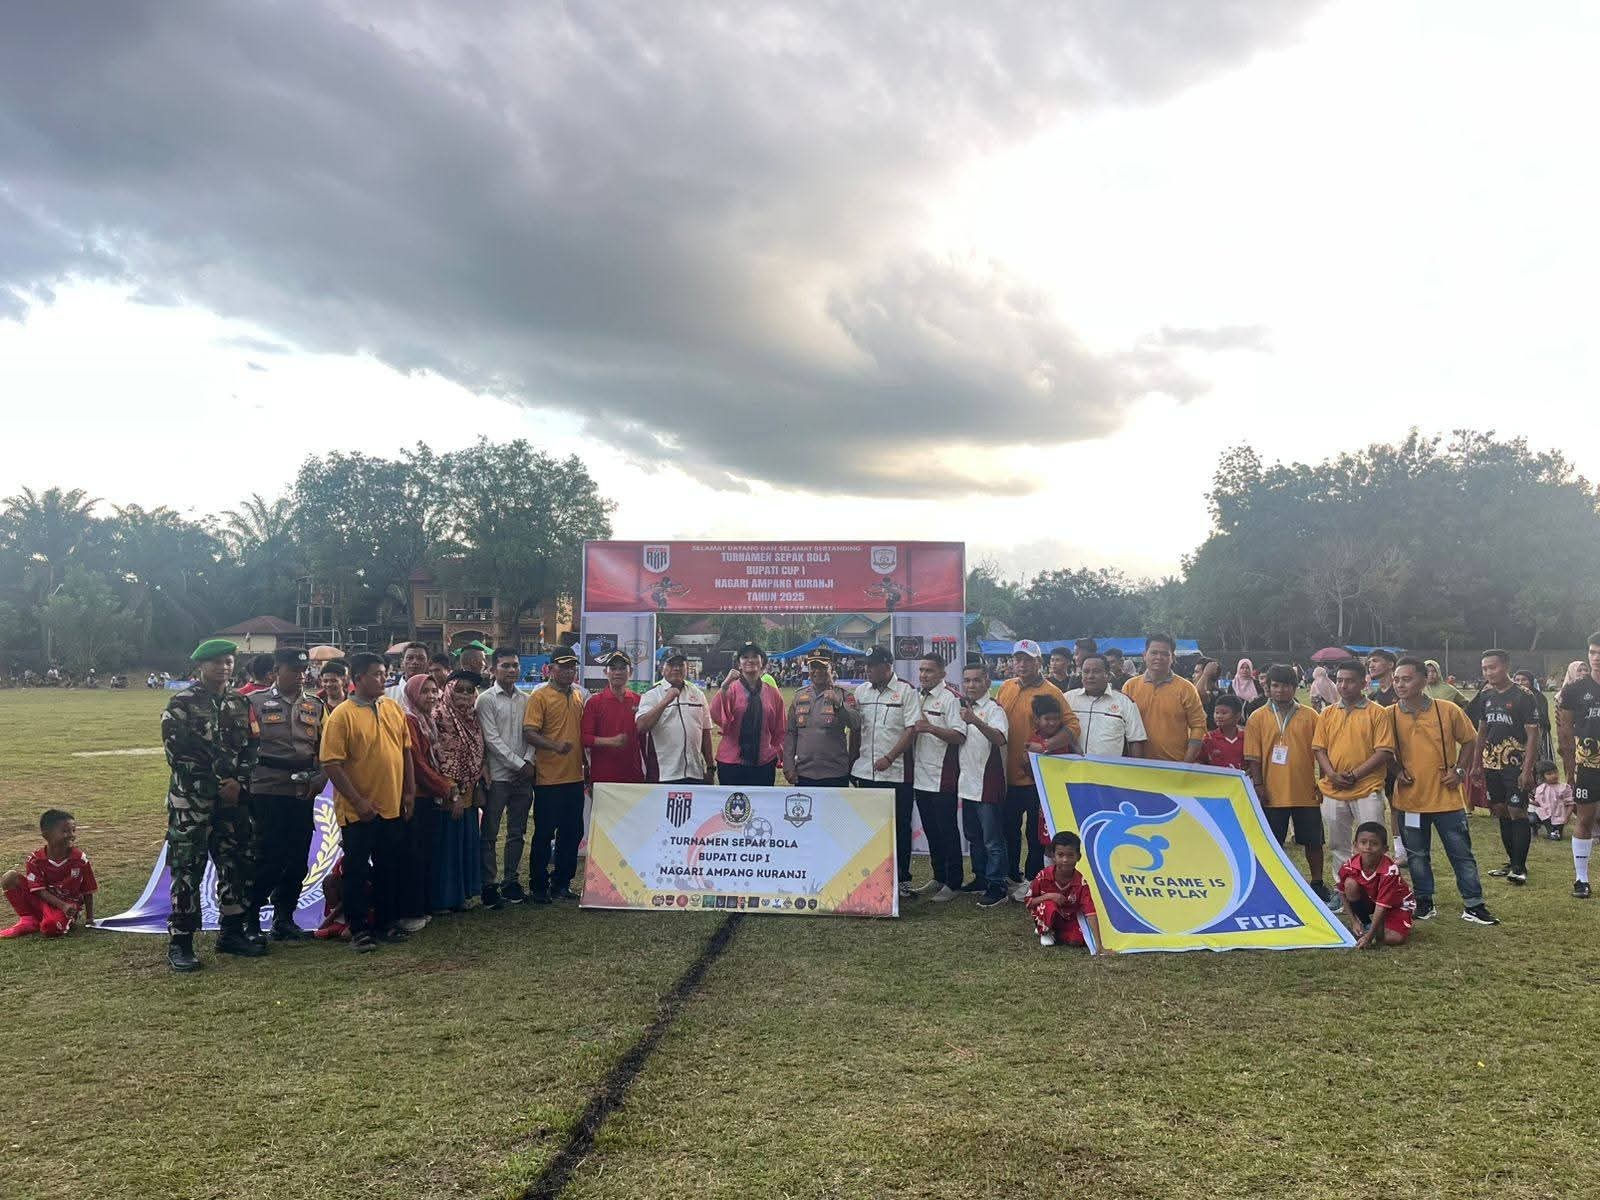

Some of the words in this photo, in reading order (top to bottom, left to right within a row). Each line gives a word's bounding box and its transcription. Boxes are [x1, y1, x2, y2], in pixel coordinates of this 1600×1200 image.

[721, 552, 772, 561] TURNAMEN
[775, 552, 804, 562] SEPAK
[807, 552, 831, 562] BOLA
[746, 566, 778, 575] BUPATI
[781, 566, 799, 575] CUP
[715, 579, 749, 588] NAGARI
[752, 579, 792, 588] AMPANG
[795, 579, 833, 588] KURANJI
[747, 592, 776, 602] TAHUN
[780, 592, 805, 601] 2025
[1576, 788, 1588, 799] 88
[670, 836, 729, 846] TURNAMEN
[731, 838, 766, 847] SEPAK
[769, 839, 798, 848] BOLA
[698, 852, 737, 862] BUPATI
[740, 853, 762, 862] CUP
[660, 866, 704, 876] NAGARI
[706, 868, 753, 877] AMPANG
[757, 869, 806, 879] KURANJI
[1120, 874, 1146, 885] MY
[1153, 876, 1205, 887] GAME
[1209, 878, 1226, 887] IS
[1125, 887, 1163, 898] FAIR
[1168, 888, 1208, 899] PLAY
[1234, 913, 1300, 930] FIFA
